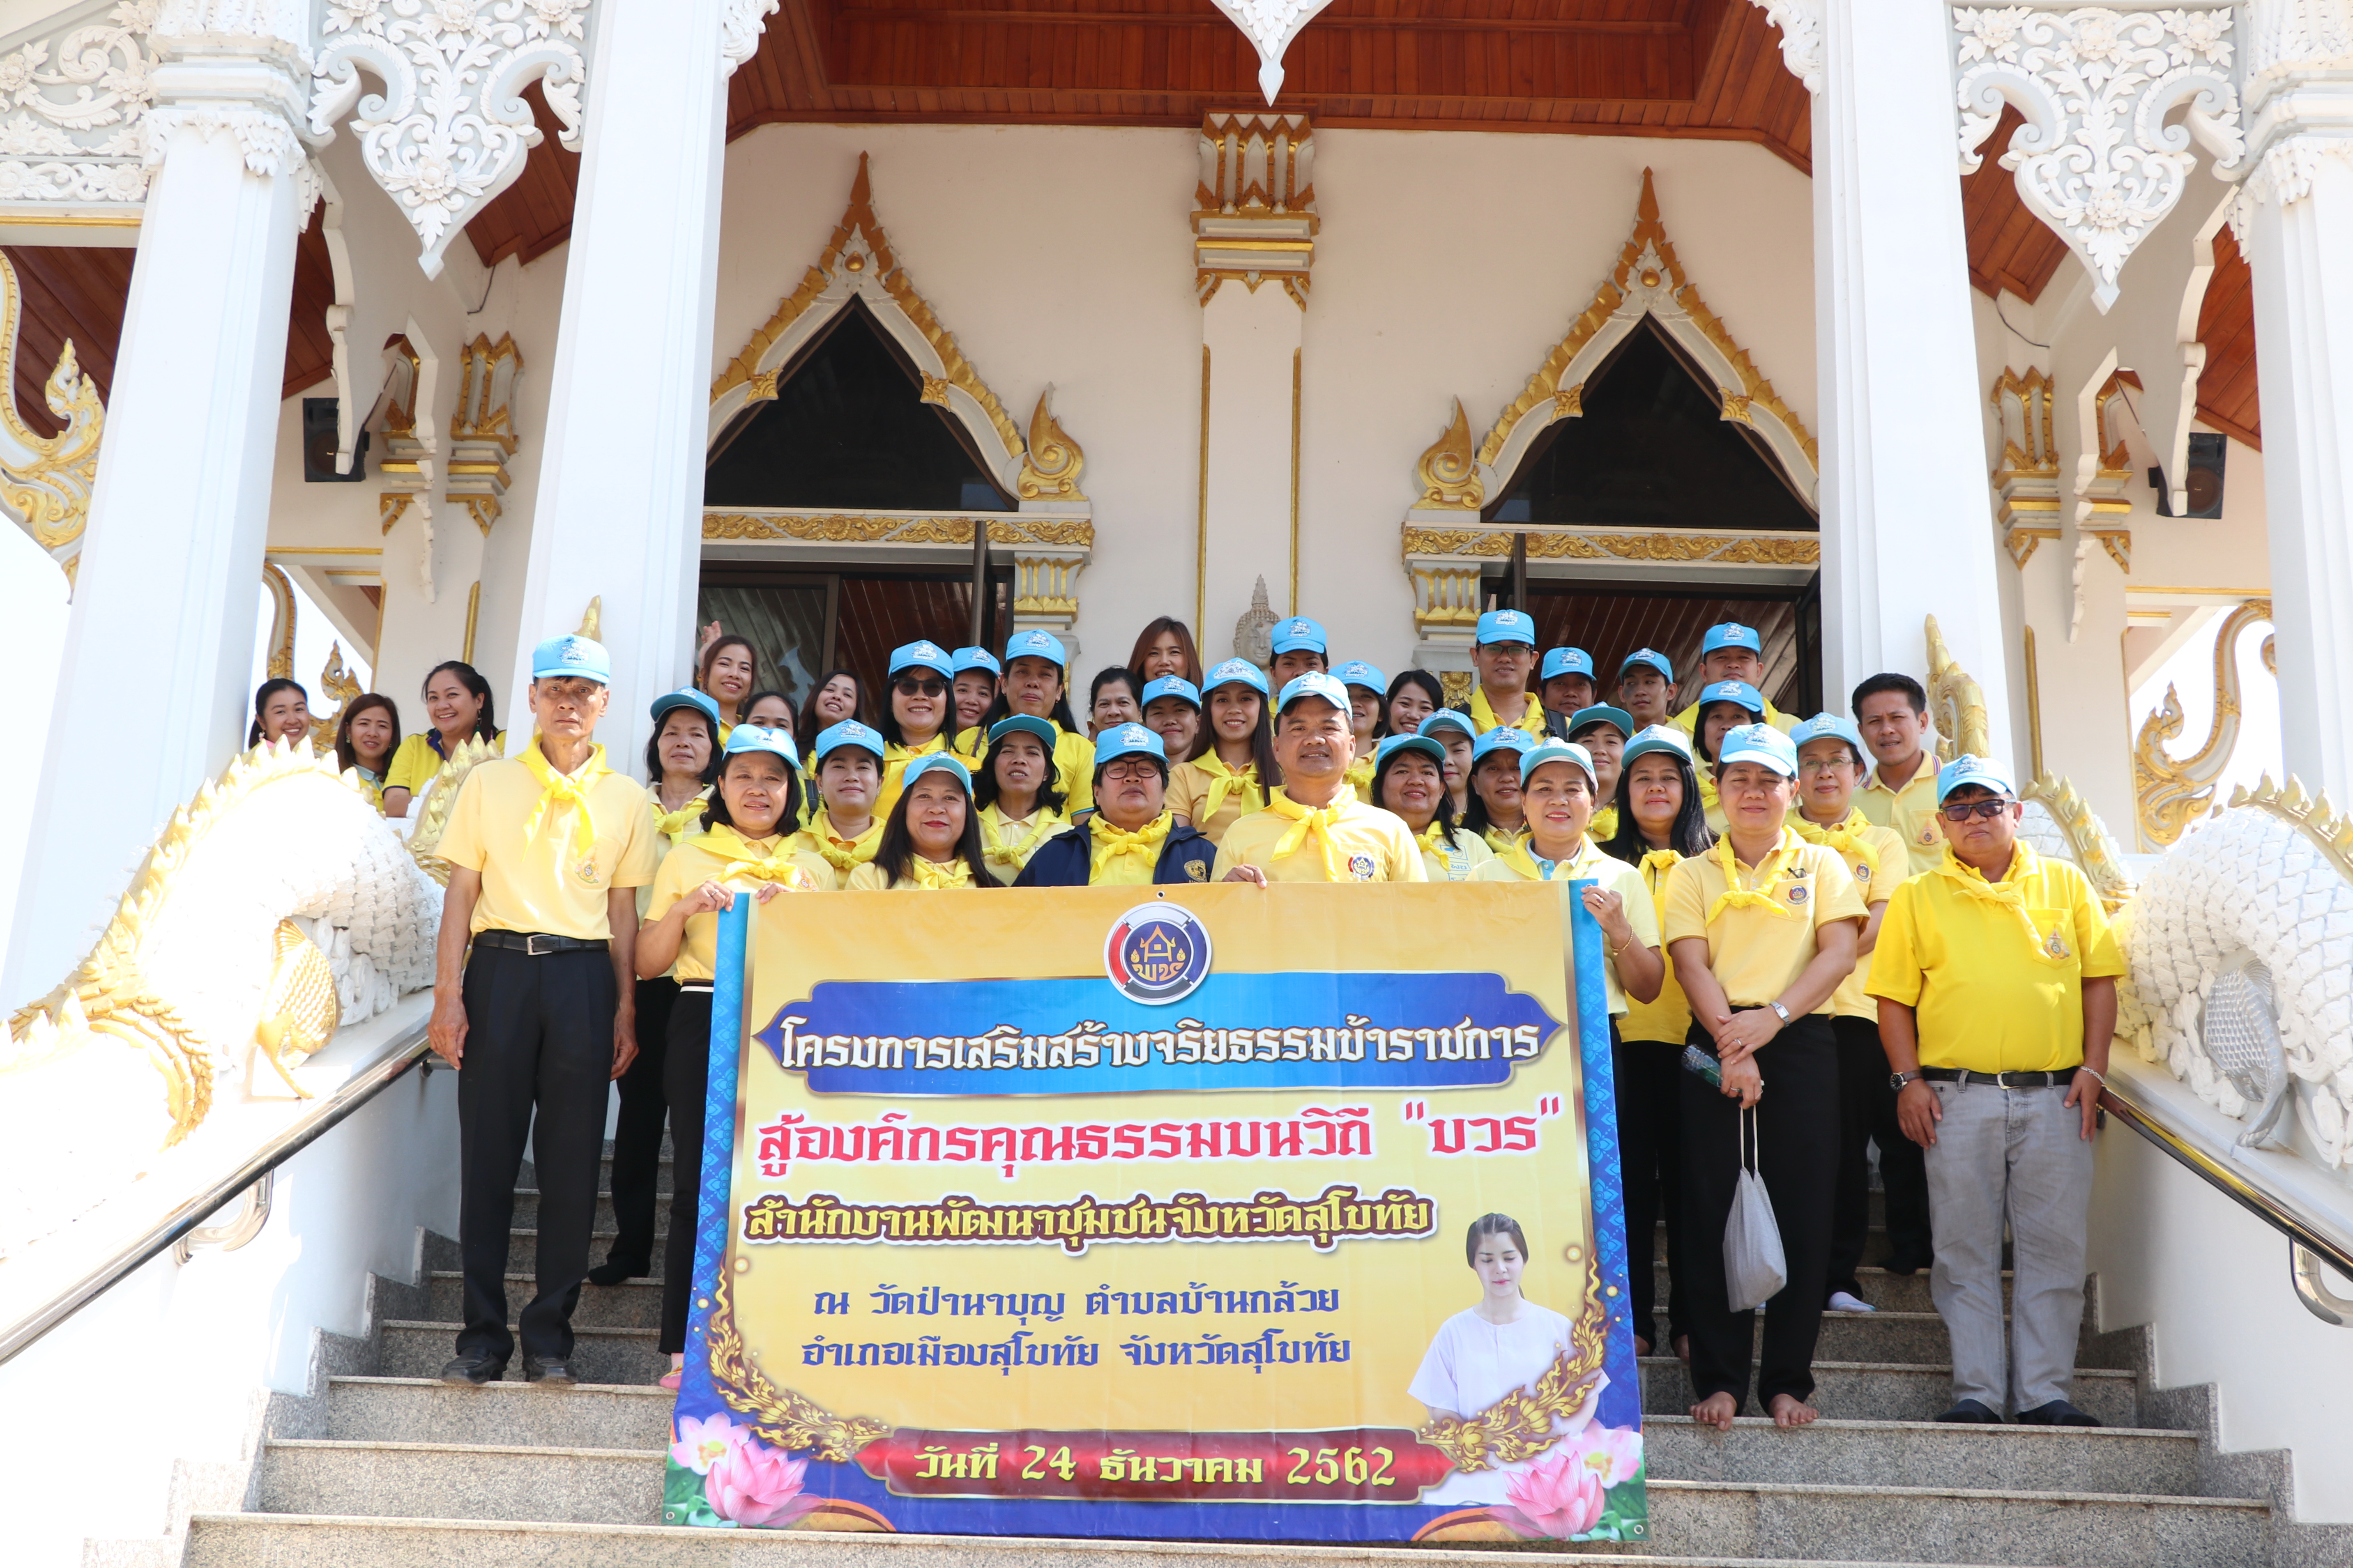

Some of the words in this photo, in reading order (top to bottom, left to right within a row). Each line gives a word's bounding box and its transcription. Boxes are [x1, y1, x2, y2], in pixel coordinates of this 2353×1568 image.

[779, 1013, 1541, 1069] โครงการเสริมสร้างจริยธรรมข้าราชการ
[1404, 1096, 1559, 1154] "บวร"
[748, 1190, 1429, 1247] สำนักงานพัฒนาชุมชนจังหวัดสุโขทัย
[813, 1291, 850, 1315] ณ
[869, 1283, 1066, 1326] วัดป่านาบุญ
[1084, 1280, 1340, 1315] ตำบลบ้านกล้วย
[801, 1330, 1099, 1376] อำเภอเมืองสุโขทัย
[1119, 1328, 1351, 1374] จังหวัดสุโขทัย
[914, 1442, 999, 1478] วันที่
[1021, 1445, 1077, 1481] 24
[1099, 1448, 1263, 1483] ธันวาคม
[1287, 1446, 1395, 1486] 2562
